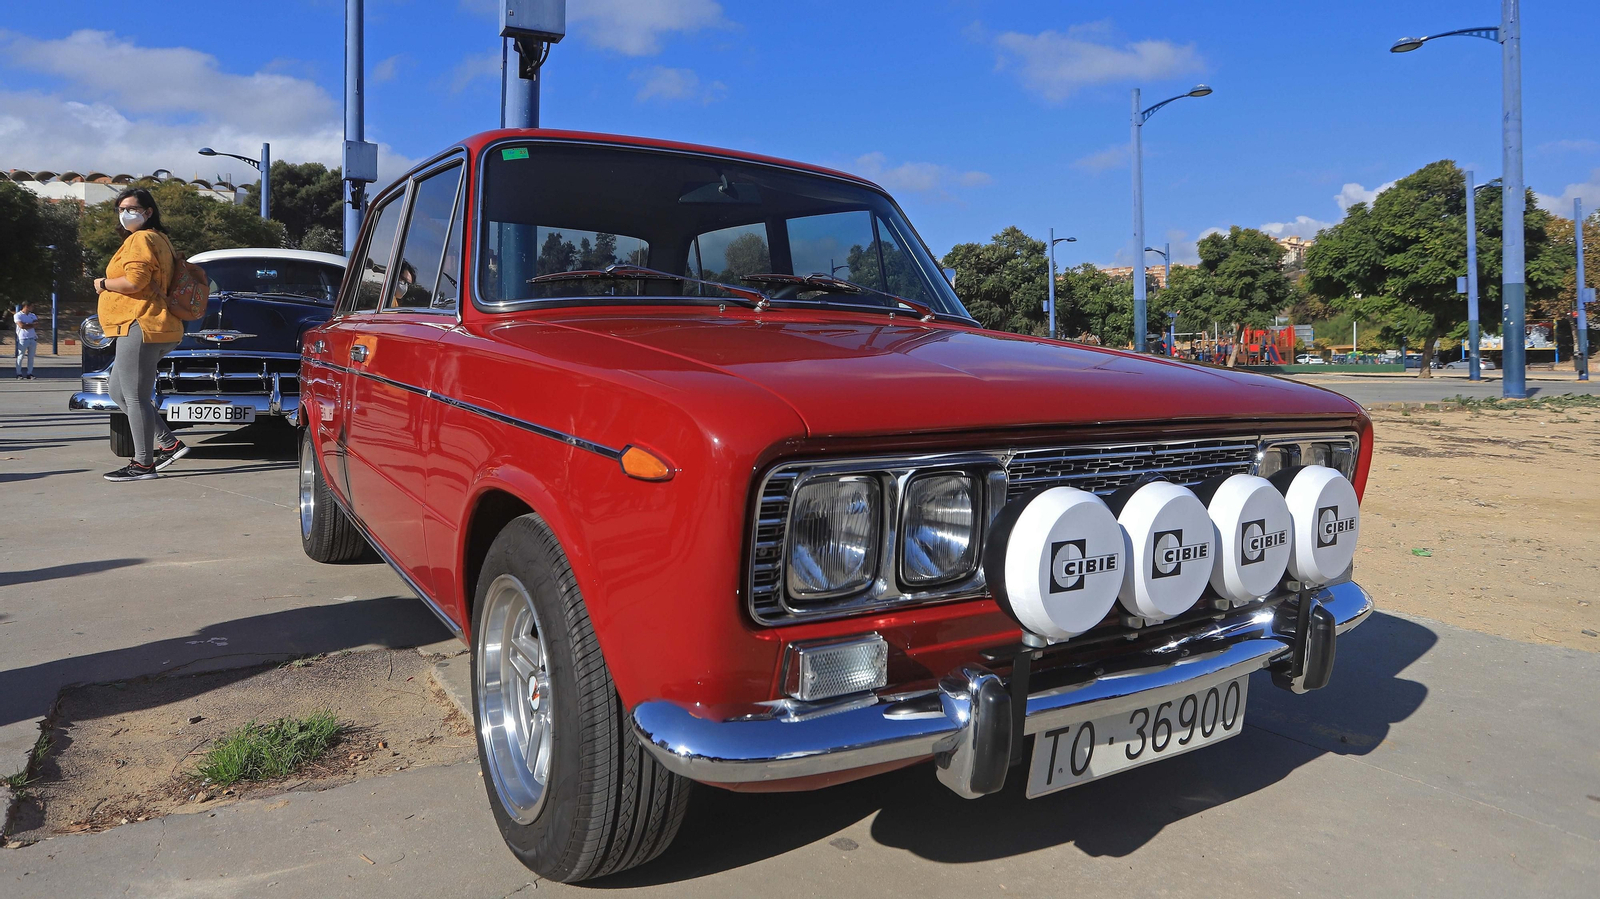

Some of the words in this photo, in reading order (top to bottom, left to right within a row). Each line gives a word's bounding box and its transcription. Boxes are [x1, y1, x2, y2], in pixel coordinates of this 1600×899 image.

[171, 406, 180, 419] H
[224, 406, 252, 420] BBF
[1124, 680, 1241, 760] 36900
